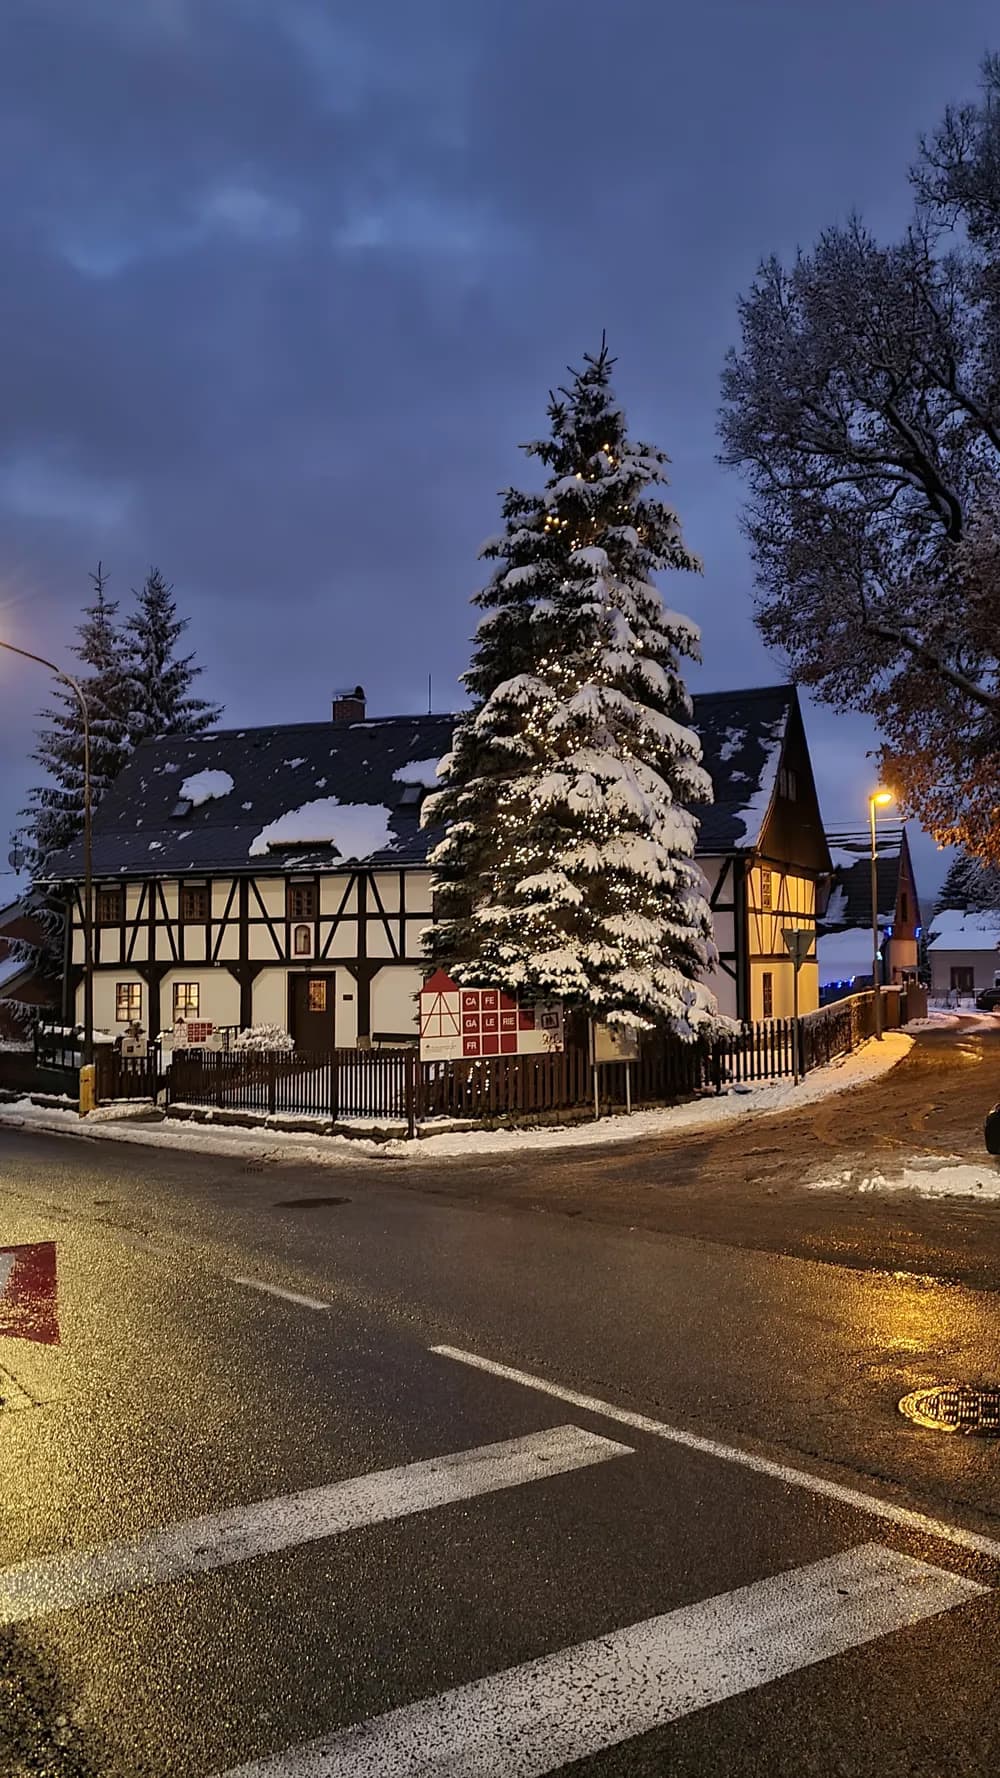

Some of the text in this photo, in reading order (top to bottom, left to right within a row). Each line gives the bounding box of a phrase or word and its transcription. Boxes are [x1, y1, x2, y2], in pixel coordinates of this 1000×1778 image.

[465, 996, 495, 1006] CA FE
[465, 1017, 515, 1028] GA LE RIE
[466, 1041, 477, 1050] FR
